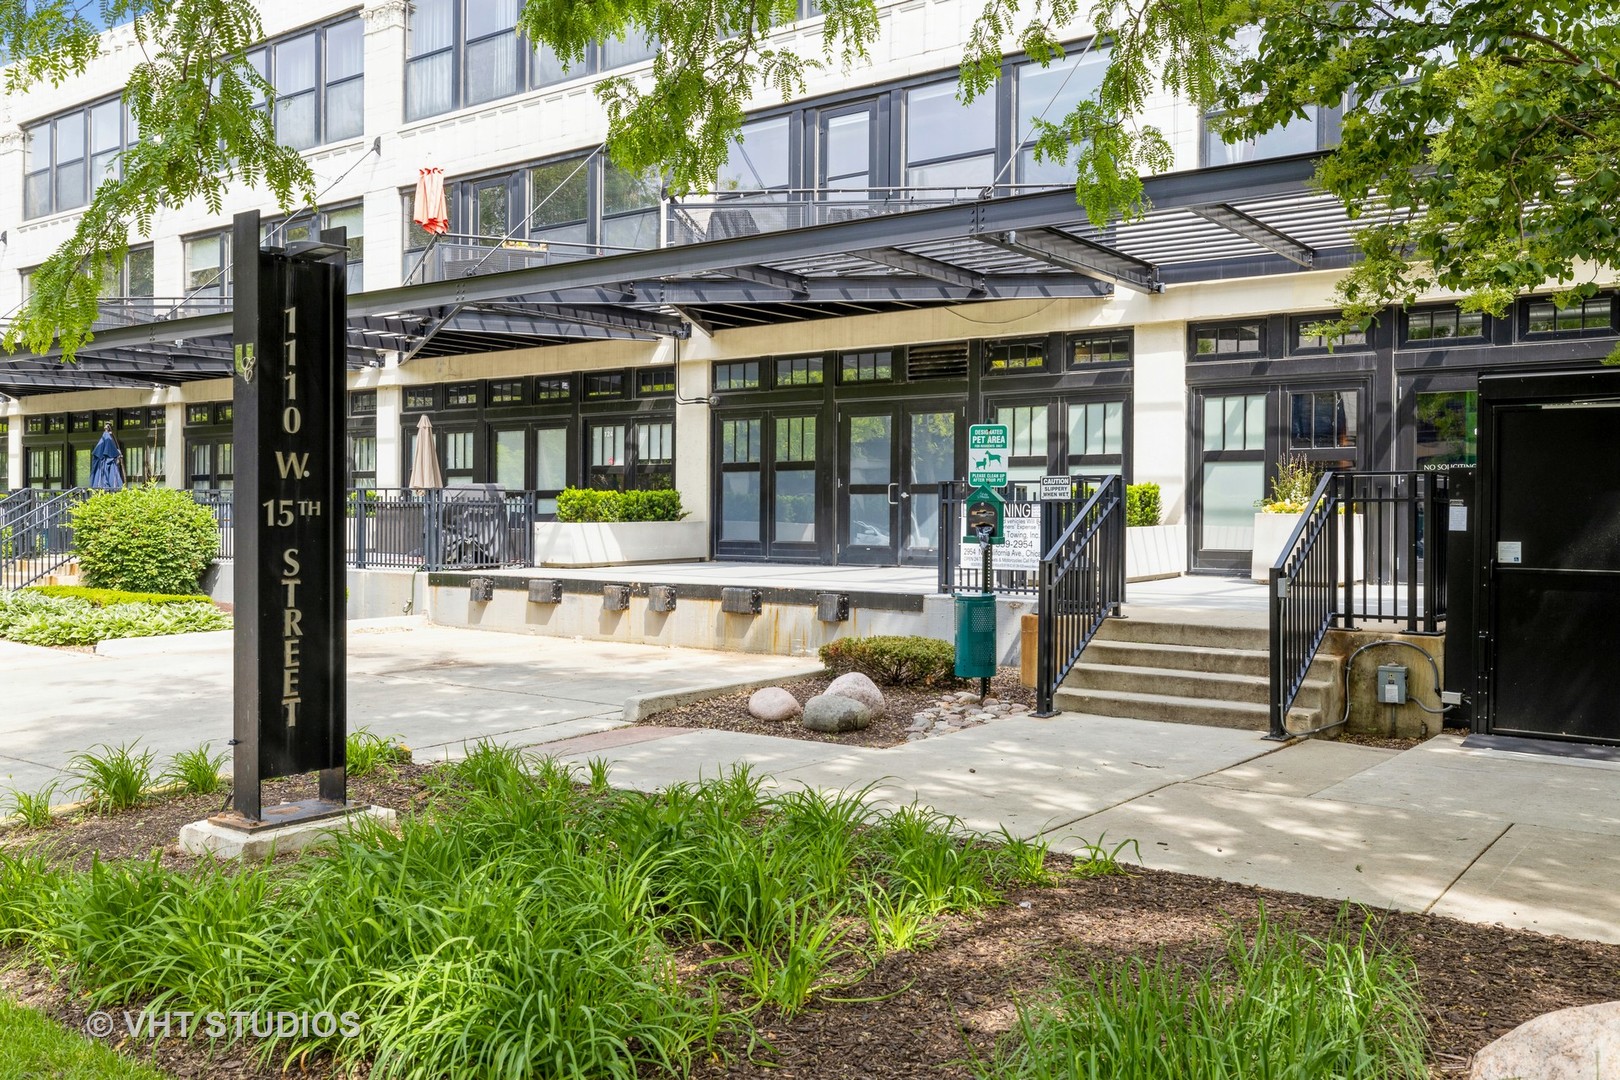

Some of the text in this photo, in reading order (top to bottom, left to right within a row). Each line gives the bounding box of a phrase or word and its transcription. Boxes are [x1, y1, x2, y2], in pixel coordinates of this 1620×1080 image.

[972, 435, 1006, 444] PET AREA
[262, 306, 321, 728] 1110 W. 15TH STREET
[1004, 503, 1031, 518] NING
